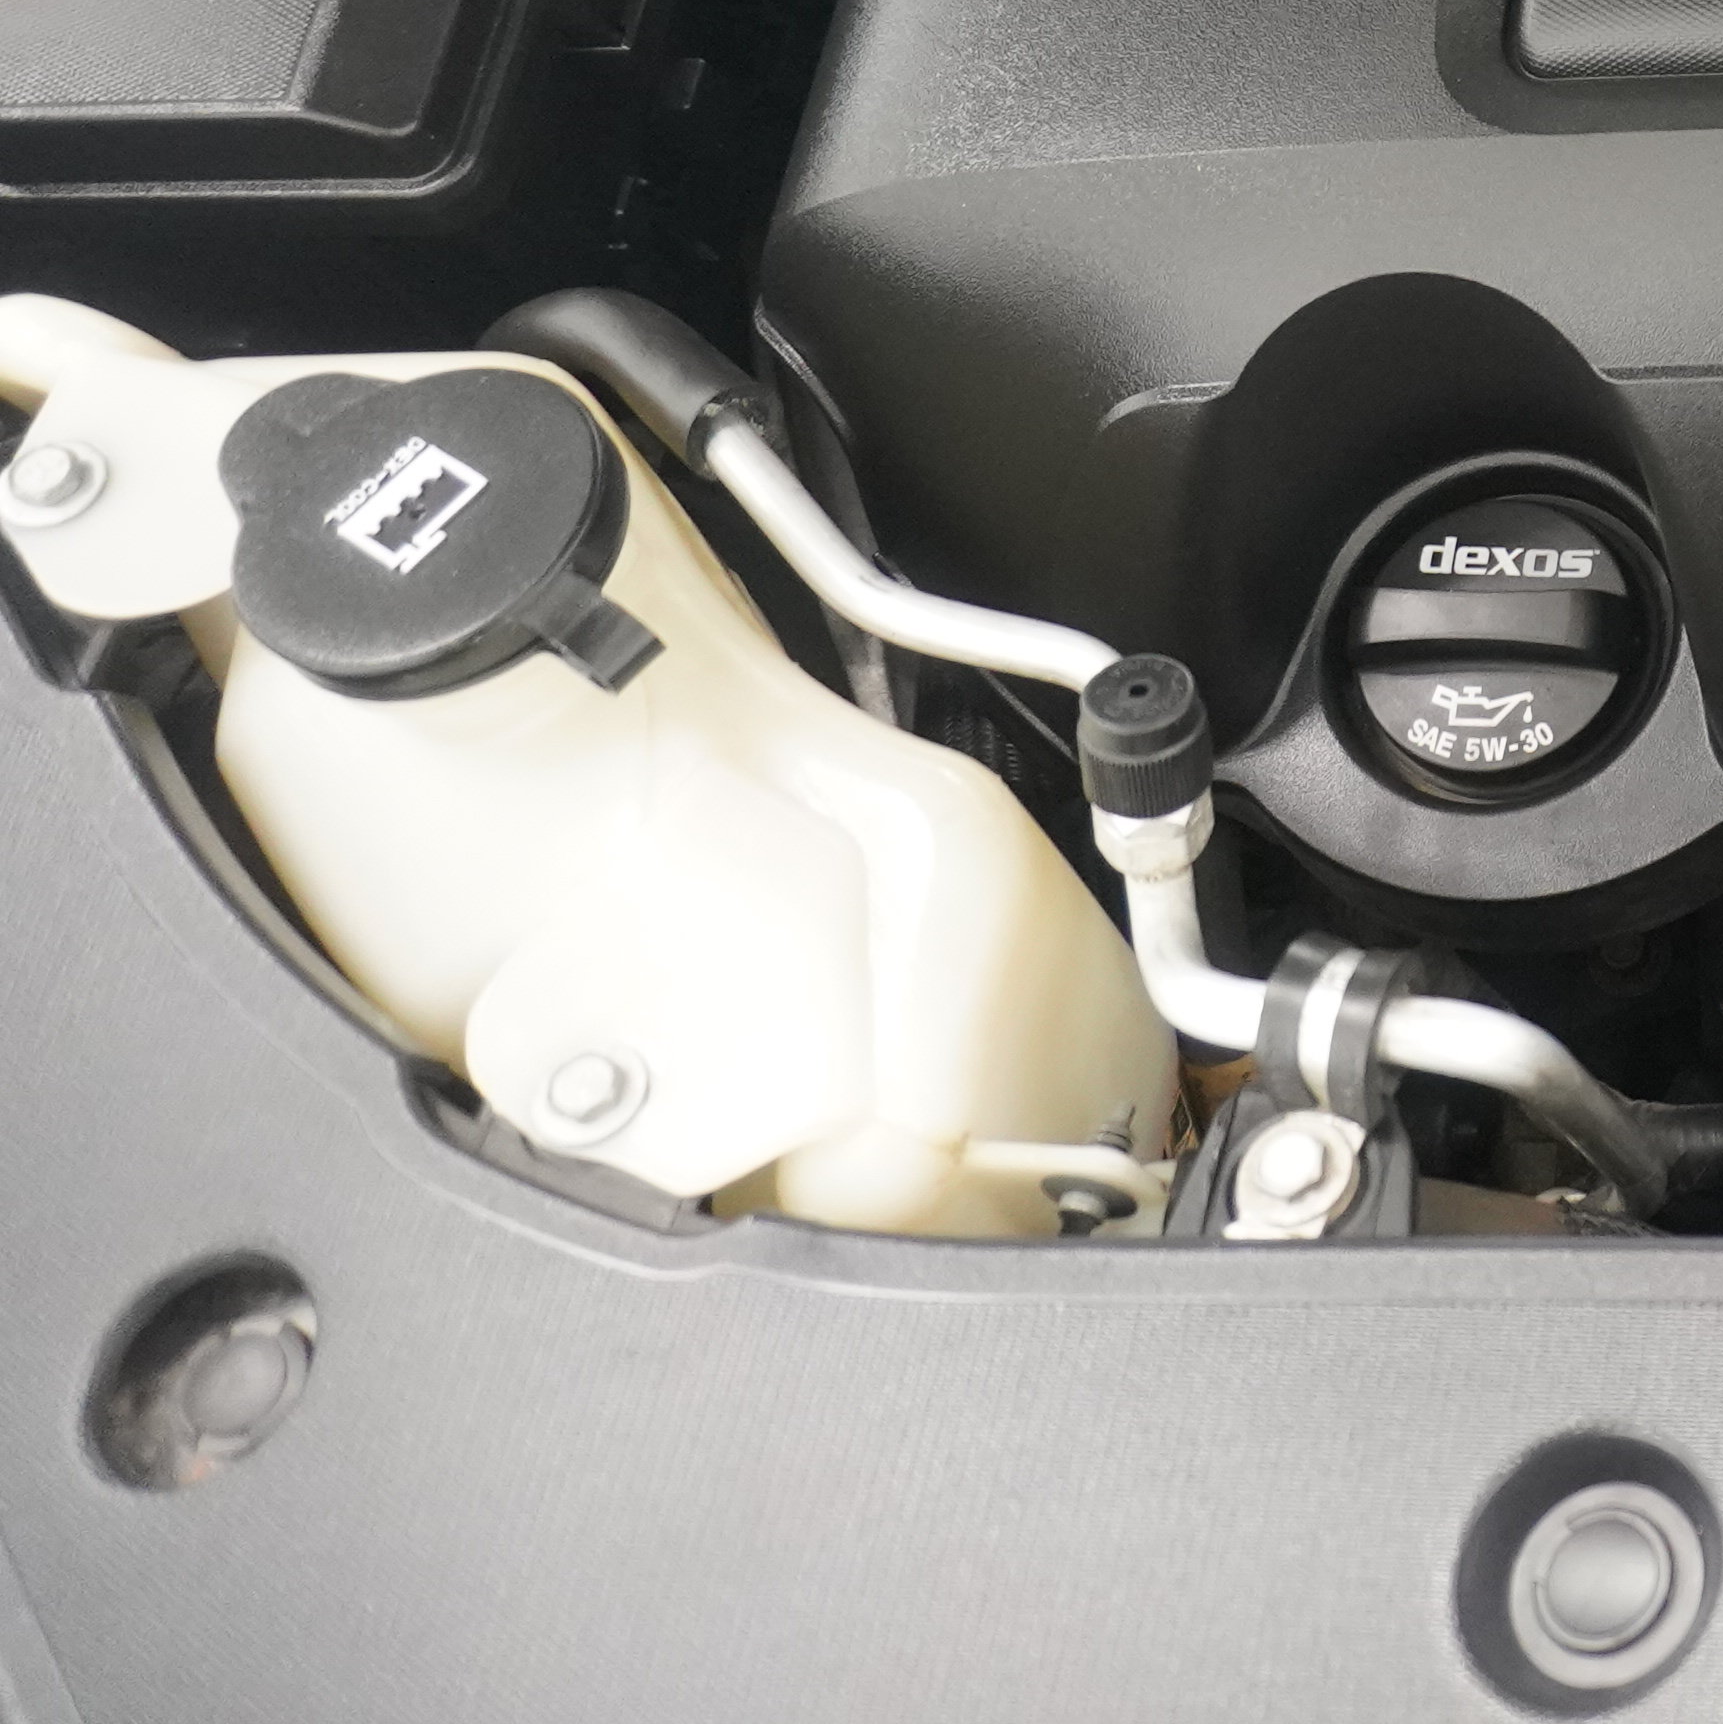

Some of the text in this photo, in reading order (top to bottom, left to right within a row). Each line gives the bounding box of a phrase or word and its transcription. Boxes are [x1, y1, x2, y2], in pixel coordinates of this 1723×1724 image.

[1418, 535, 1594, 579] dexos
[1406, 717, 1555, 763] SAE 5W-30
